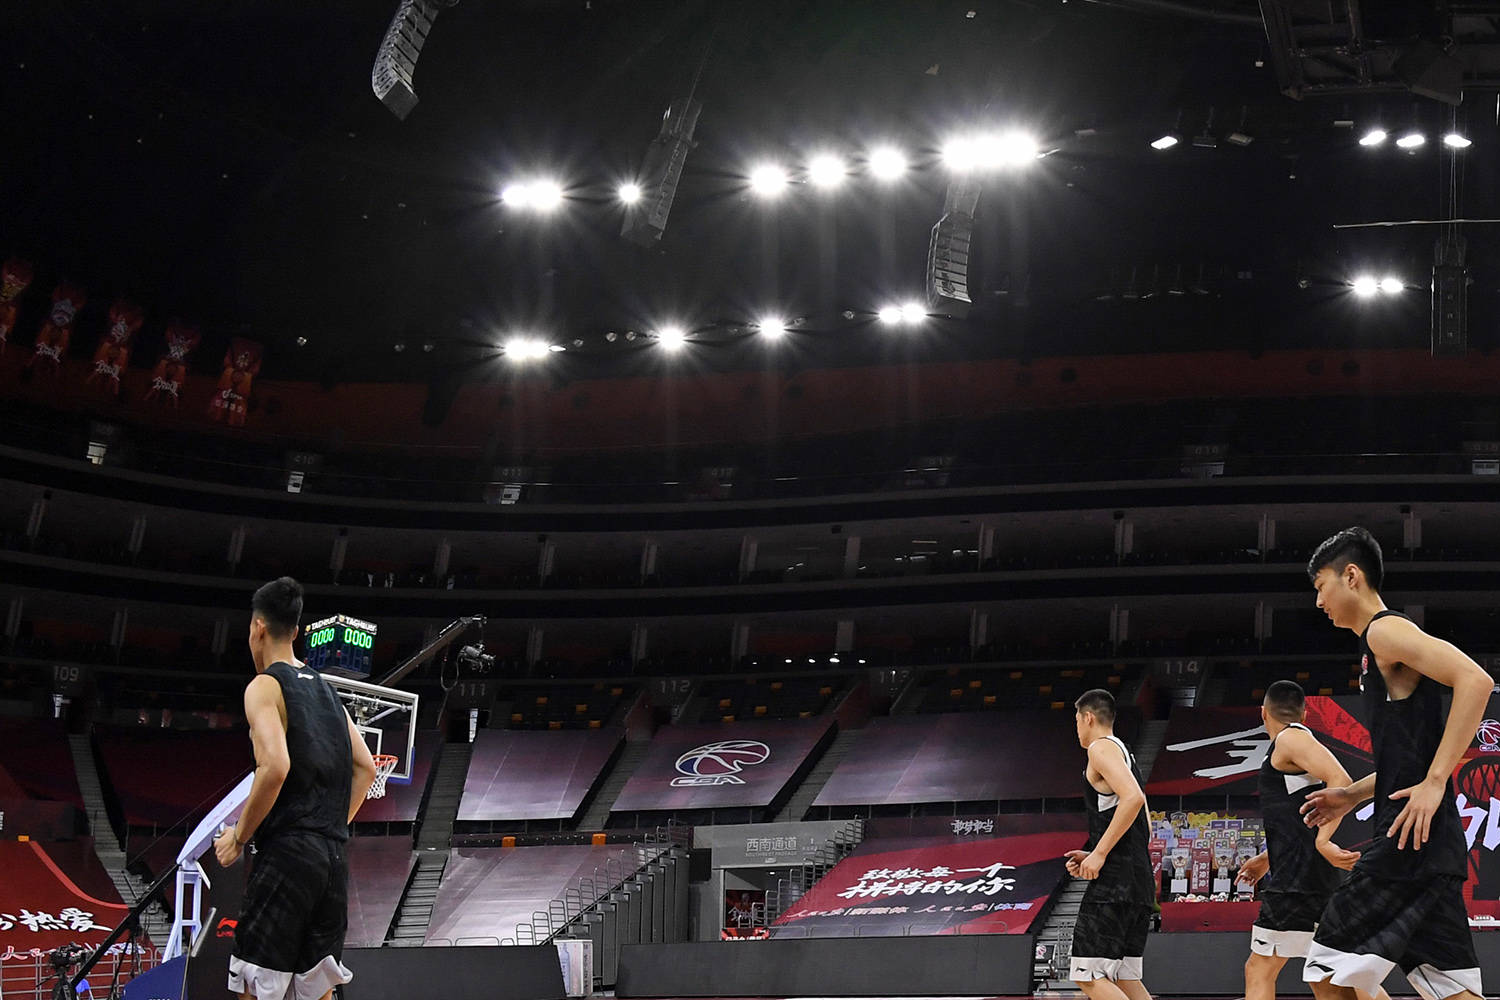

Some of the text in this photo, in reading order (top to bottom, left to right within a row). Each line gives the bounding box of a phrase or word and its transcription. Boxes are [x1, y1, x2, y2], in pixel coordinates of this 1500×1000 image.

[54, 665, 79, 681] 109
[1164, 660, 1199, 675] 114
[460, 683, 486, 697] 111
[660, 680, 690, 693] 112
[670, 774, 746, 787] CBA
[746, 837, 797, 852] 西南通道
[836, 876, 1016, 900] 拼搏的你
